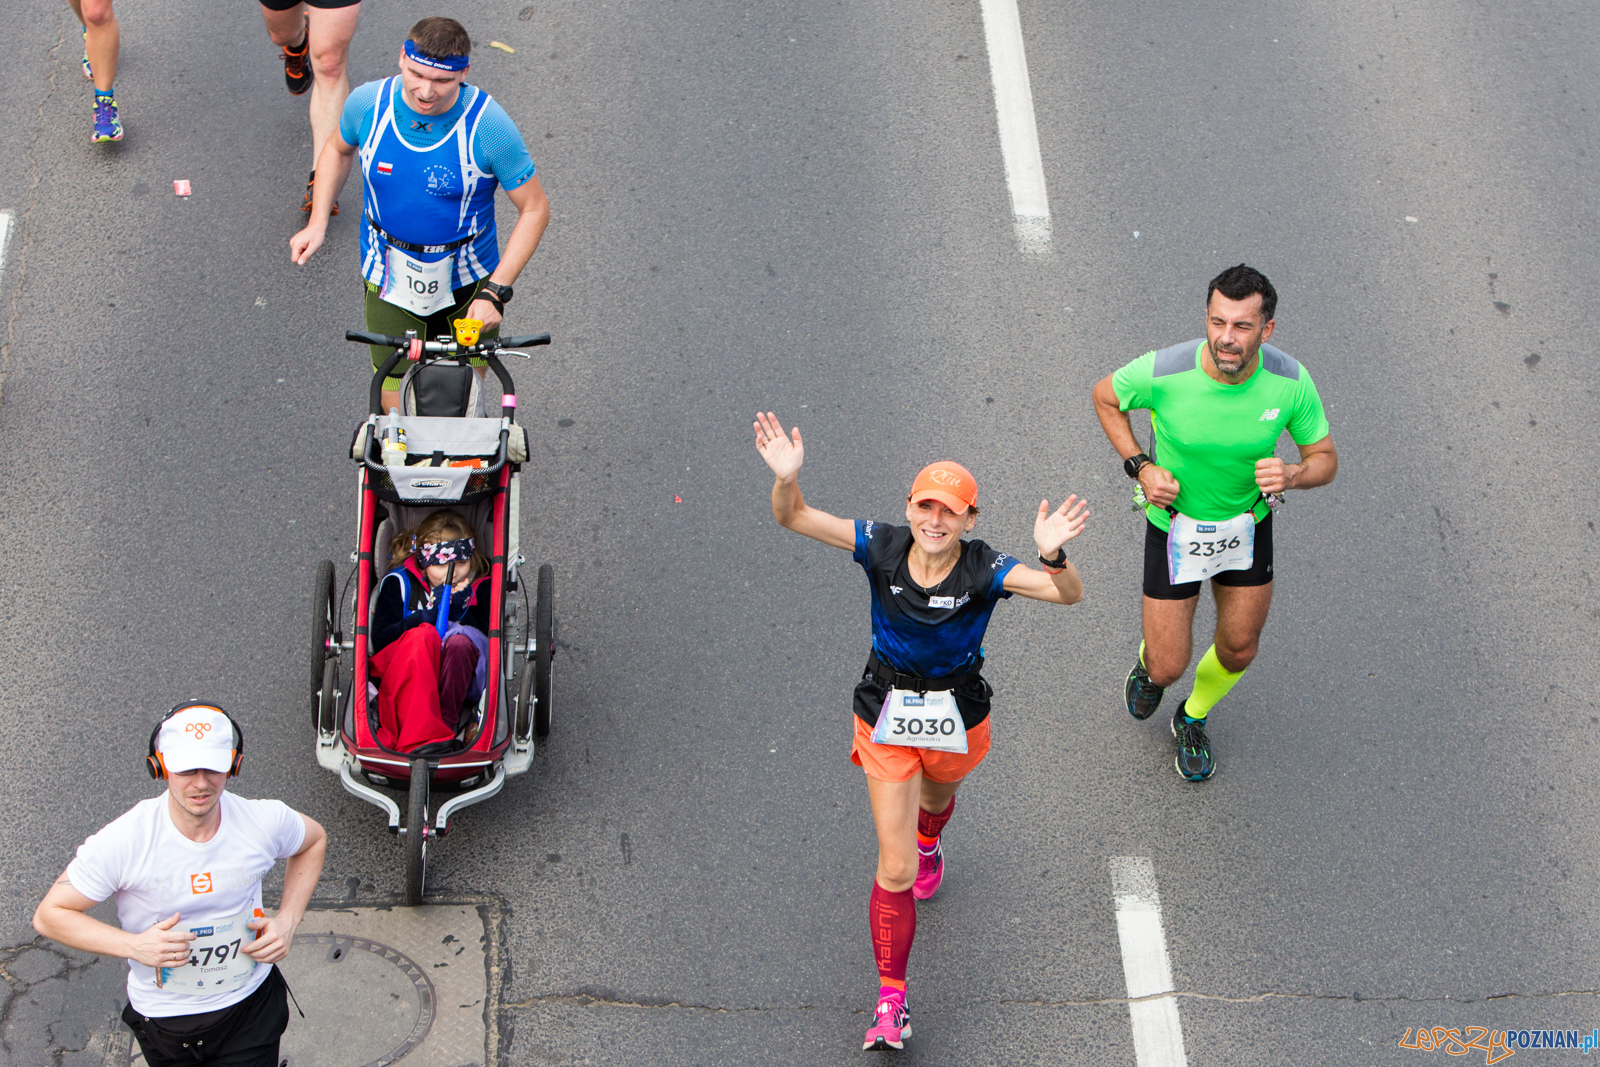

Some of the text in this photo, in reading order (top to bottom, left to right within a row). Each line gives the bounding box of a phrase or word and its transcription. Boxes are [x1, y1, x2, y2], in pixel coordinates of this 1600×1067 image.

[406, 275, 439, 295] 108
[928, 469, 961, 488] Run
[1189, 535, 1240, 556] 2336
[185, 723, 212, 739] pgo
[892, 717, 956, 736] 3030
[187, 938, 241, 967] 4797
[200, 965, 228, 974] Tomasz
